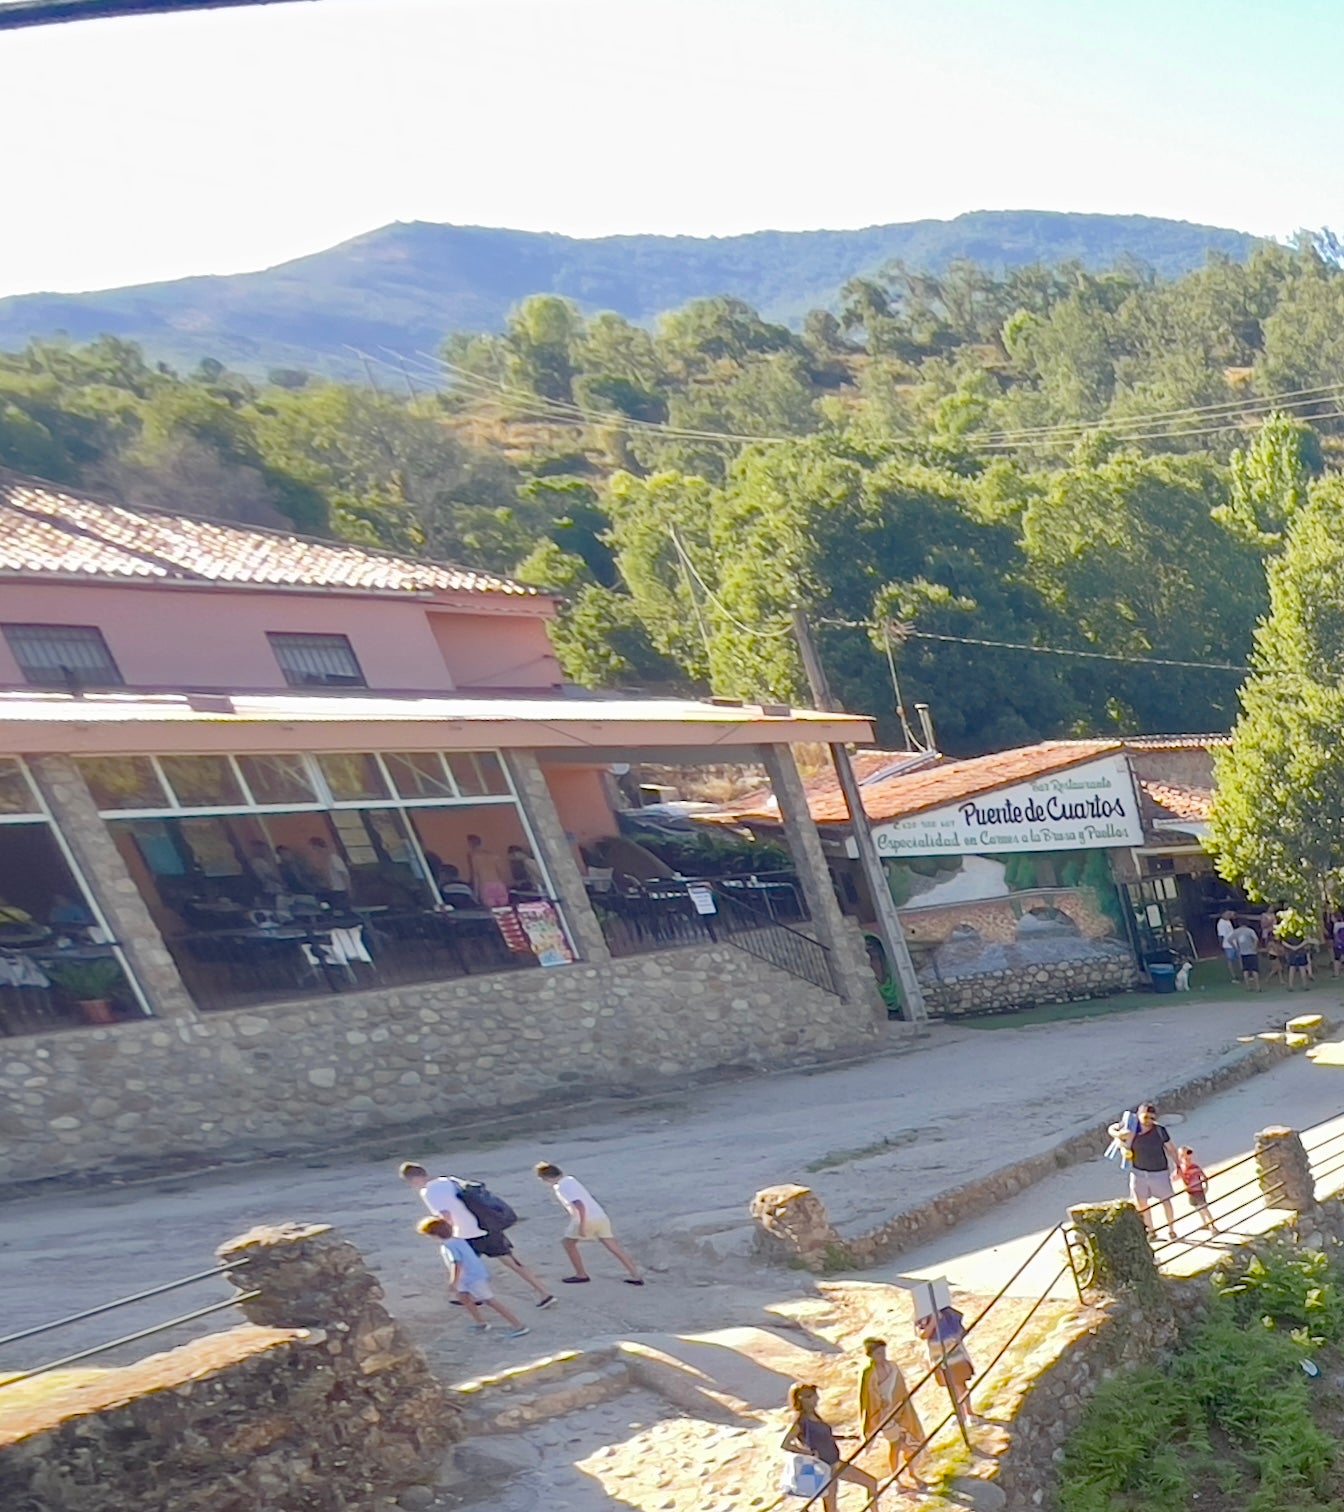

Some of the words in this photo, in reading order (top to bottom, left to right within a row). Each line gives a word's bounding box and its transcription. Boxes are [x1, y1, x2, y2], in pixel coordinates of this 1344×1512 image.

[1030, 781, 1049, 792] Bar
[1050, 776, 1112, 793] Restaurante
[958, 798, 1022, 827] Puente
[1025, 797, 1046, 822] de
[1047, 794, 1126, 821] Cuartos
[877, 832, 960, 853] Especialidad
[964, 836, 977, 846] en
[1021, 834, 1029, 842] a
[1030, 828, 1041, 842] la
[1040, 828, 1076, 842] Brasa
[1078, 831, 1086, 844] y
[1084, 824, 1129, 839] Paellas
